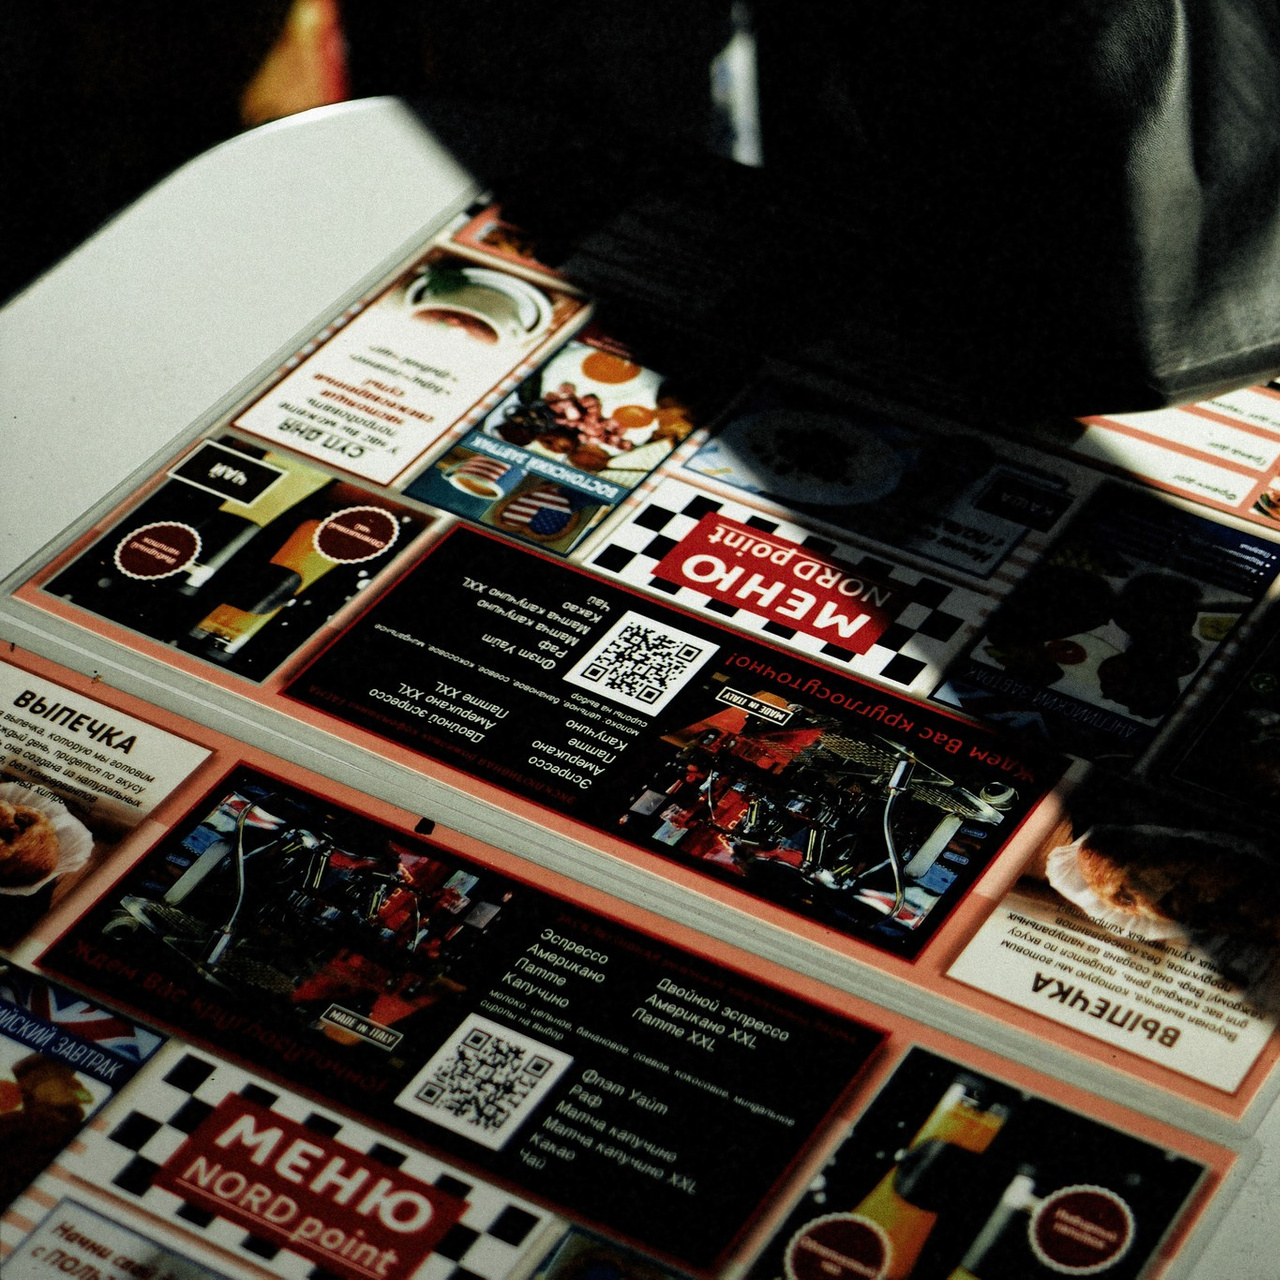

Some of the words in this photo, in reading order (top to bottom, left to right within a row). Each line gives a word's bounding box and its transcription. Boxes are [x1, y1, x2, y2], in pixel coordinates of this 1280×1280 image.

[278, 420, 324, 442] ДНЯ
[322, 436, 365, 459] СУП
[472, 437, 528, 464] ЗАВТРАК
[209, 463, 247, 485] ЧАЙ
[523, 457, 618, 498] БОСТОНСКИЙ
[709, 524, 797, 565] point
[462, 576, 488, 593] XXL
[683, 555, 868, 637] МЕНЮ
[792, 558, 888, 607] NORD
[477, 599, 534, 626] капучино
[488, 588, 546, 615] капучино
[562, 601, 603, 623] Какао
[587, 595, 611, 612] Чай
[374, 623, 425, 647] миндальное
[535, 622, 580, 647] Матча
[546, 611, 591, 635] Матча
[428, 645, 475, 668] кокосовое,
[481, 634, 516, 654] Уайт
[538, 640, 568, 659] Раф
[518, 649, 556, 670] Флэт
[478, 665, 510, 683] соевое,
[966, 666, 1032, 699] ЗАВТРАК
[369, 688, 428, 718] эспрессо
[398, 682, 425, 701] XXL
[435, 681, 462, 699] XXL
[513, 679, 560, 705] банановое,
[570, 693, 600, 709] выбор
[722, 692, 748, 706] ITALY
[726, 654, 913, 731] круглосуточно!
[425, 695, 496, 730] Американо
[462, 693, 509, 719] Латте
[563, 700, 602, 721] цельное,
[600, 704, 613, 714] на
[612, 710, 648, 728] сиропы
[747, 701, 760, 710] in
[758, 705, 785, 721] MADE
[1033, 692, 1137, 738] АНГЛИЙСКИЙ
[14, 690, 136, 753] ВЫПЕЧКА
[428, 714, 485, 743] Двойной
[565, 719, 628, 751] Капучино
[602, 718, 640, 736] молоко:
[3, 713, 45, 737] выпечка,
[47, 733, 93, 756] которую
[92, 752, 110, 763] мы
[109, 760, 155, 783] готовим
[568, 738, 616, 764] Латте
[918, 727, 963, 754] Вас
[24, 738, 50, 754] день,
[54, 750, 102, 774] придется
[101, 771, 116, 781] по
[115, 777, 146, 795] вкусу
[532, 740, 605, 776] Американо
[970, 744, 1036, 783] Ждем
[4, 742, 23, 755] она
[22, 751, 62, 772] создана
[62, 769, 76, 778] из
[75, 775, 142, 807] натуральных
[8, 758, 28, 772] без
[27, 769, 99, 803] консервантов
[528, 756, 592, 789] Эспрессо
[1008, 913, 1085, 948] натуральных
[1008, 926, 1042, 946] вкусу
[1055, 914, 1139, 954] консервантов
[540, 928, 609, 964] Эспрессо
[1000, 940, 1053, 965] готовим
[1043, 942, 1059, 952] по
[1086, 944, 1101, 955] из
[1136, 950, 1162, 966] без
[515, 957, 567, 986] Латте
[527, 943, 605, 983] Американо
[1054, 962, 1074, 974] мы
[1060, 949, 1116, 976] придется
[1103, 952, 1153, 975] создана
[502, 972, 569, 1008] Капучино
[1075, 970, 1129, 996] которую
[1123, 974, 1153, 990] день,
[1152, 969, 1174, 984] она
[1166, 960, 1235, 994] продуктов,
[1177, 981, 1206, 998] Ведь
[657, 978, 719, 1012] Двойной
[721, 1007, 789, 1041] эспрессо
[1033, 973, 1180, 1047] ВЫПЕЧКА
[1135, 993, 1186, 1019] выпечка,
[1152, 985, 1200, 1010] каждый
[480, 999, 517, 1020] сиропы
[518, 1017, 531, 1027] на
[531, 1022, 564, 1041] выбор
[646, 994, 726, 1034] Американо
[728, 1027, 757, 1048] XXL
[1203, 1006, 1224, 1019] вас
[329, 1010, 356, 1027] MADE
[356, 1023, 369, 1033] in
[369, 1028, 395, 1043] ITALY
[530, 1008, 572, 1031] цельное,
[576, 1026, 629, 1054] банановое,
[632, 1007, 685, 1037] Латте
[687, 1030, 716, 1052] XXL
[51, 1037, 121, 1078] ЗАВТРАК
[568, 1084, 603, 1108] Раф
[581, 1069, 625, 1095] Флэт
[628, 1089, 668, 1115] Уайт
[556, 1100, 606, 1131] Матча
[609, 1127, 677, 1162] капучино
[519, 1148, 546, 1169] Чай
[529, 1133, 576, 1160] Какао
[542, 1116, 594, 1147] Матча
[595, 1143, 664, 1178] капучино
[668, 1172, 696, 1194] XXL
[218, 1116, 431, 1231] МЕНЮ
[184, 1157, 297, 1223] NORD
[289, 1217, 397, 1280] point
[30, 1246, 46, 1258] с
[55, 1223, 112, 1259] Начни
